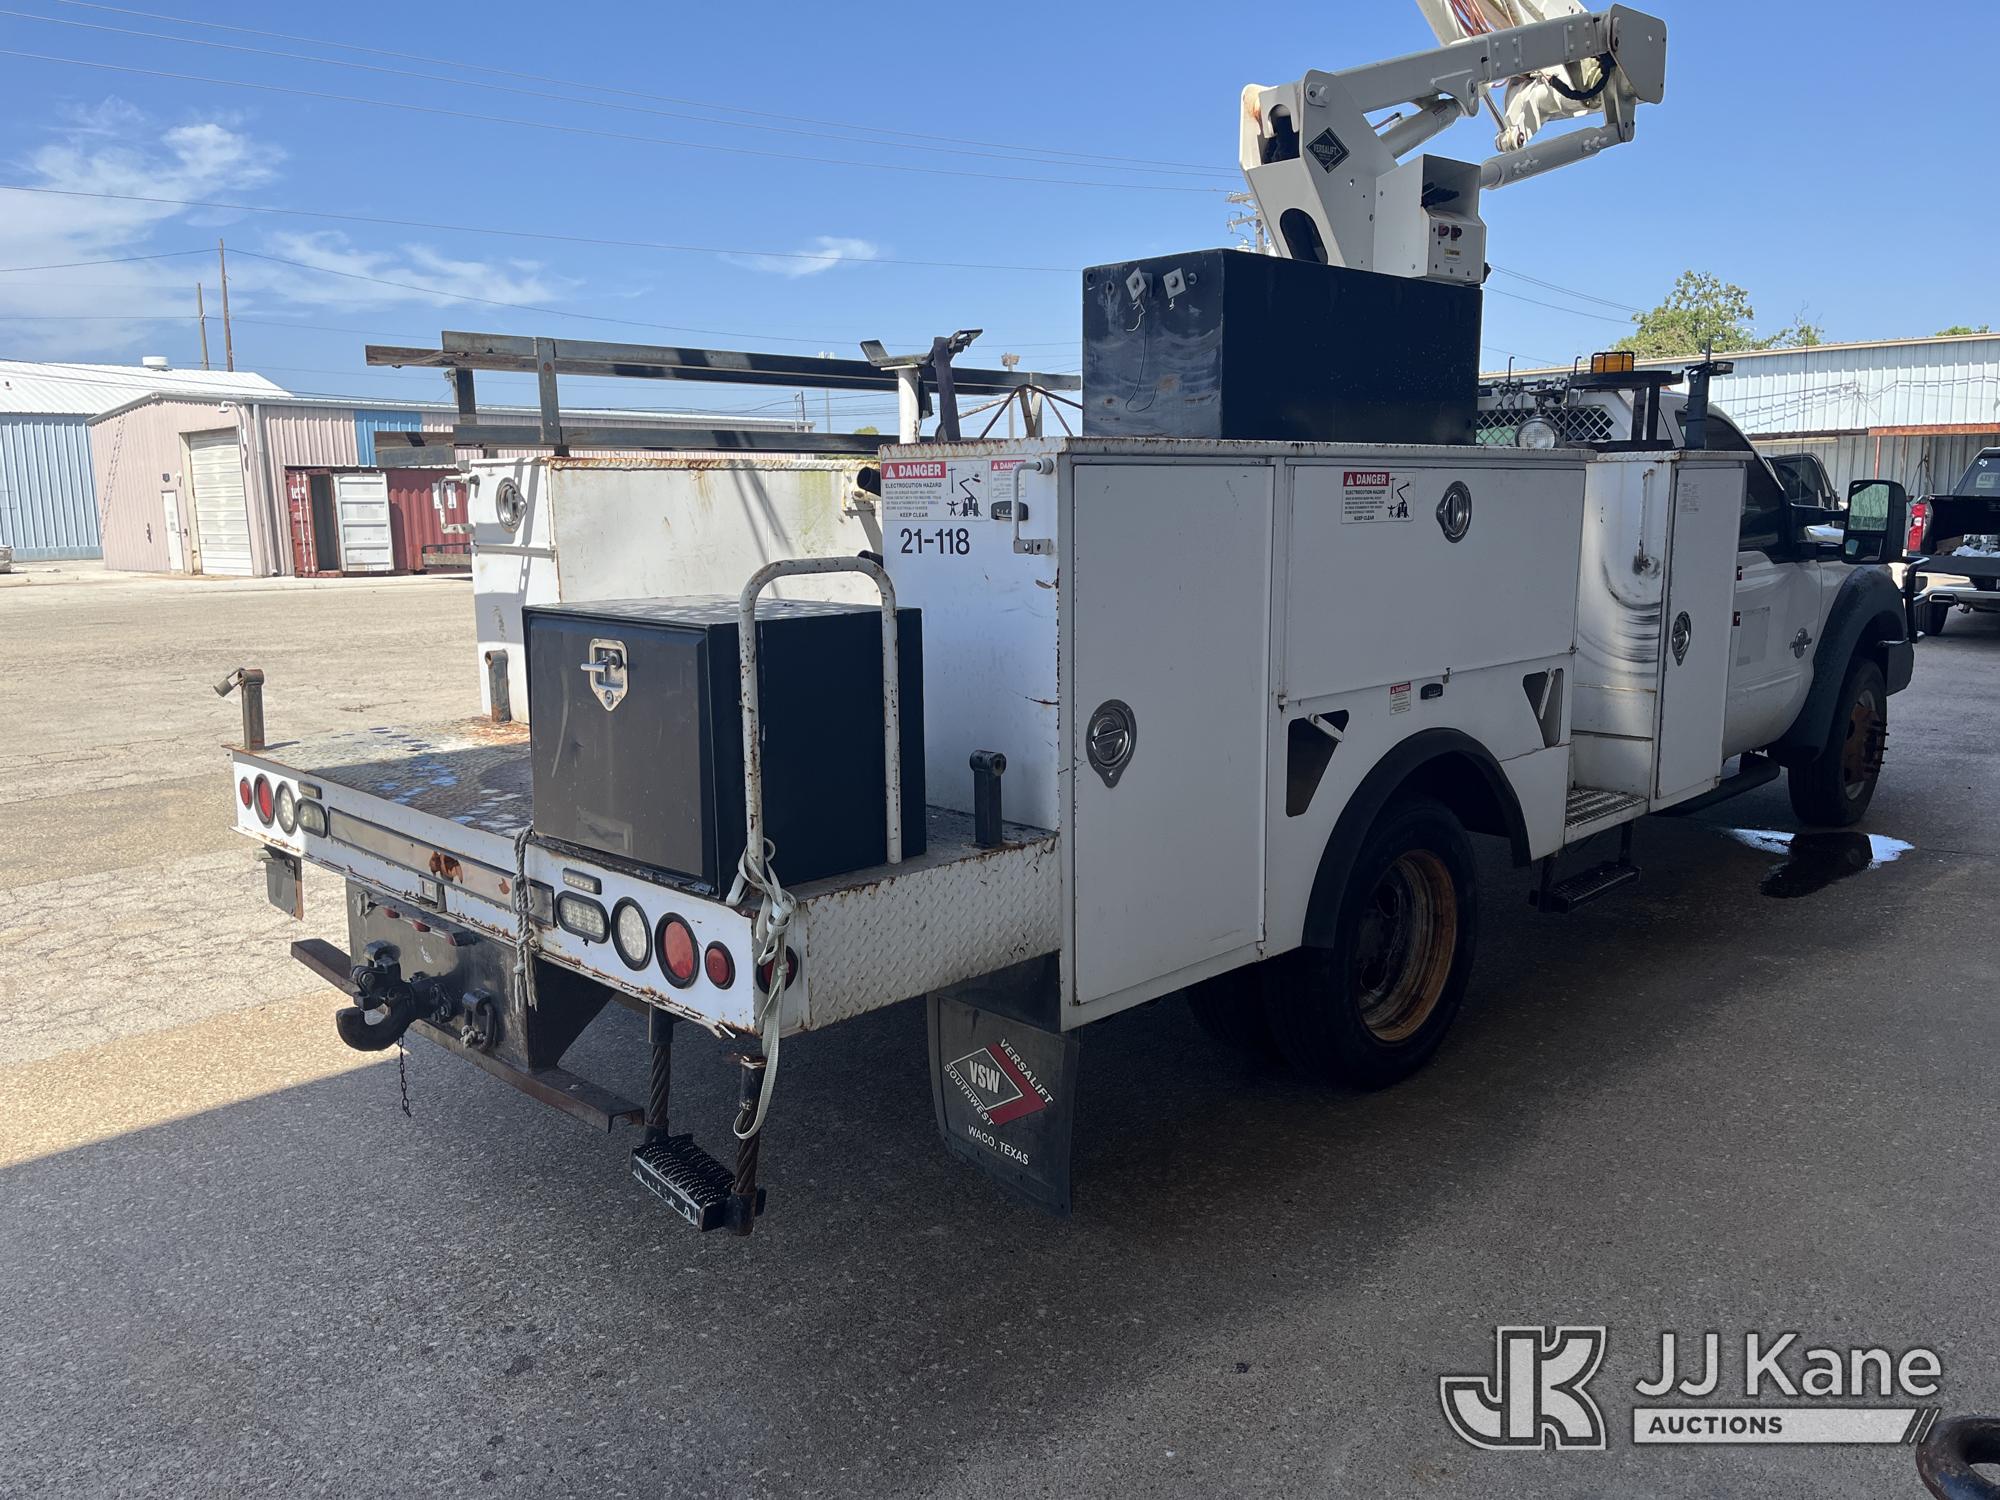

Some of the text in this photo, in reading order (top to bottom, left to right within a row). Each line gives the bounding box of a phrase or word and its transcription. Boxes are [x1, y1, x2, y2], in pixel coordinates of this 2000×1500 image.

[898, 464, 942, 477] DANGER
[1356, 474, 1387, 485] DANGER
[900, 527, 970, 555] 21-118
[969, 1060, 1000, 1094] VSW
[999, 1038, 1054, 1104] VERSALIFT
[944, 1064, 994, 1126] SOUTHWEST
[967, 1124, 1029, 1165] WACO, TEXAS
